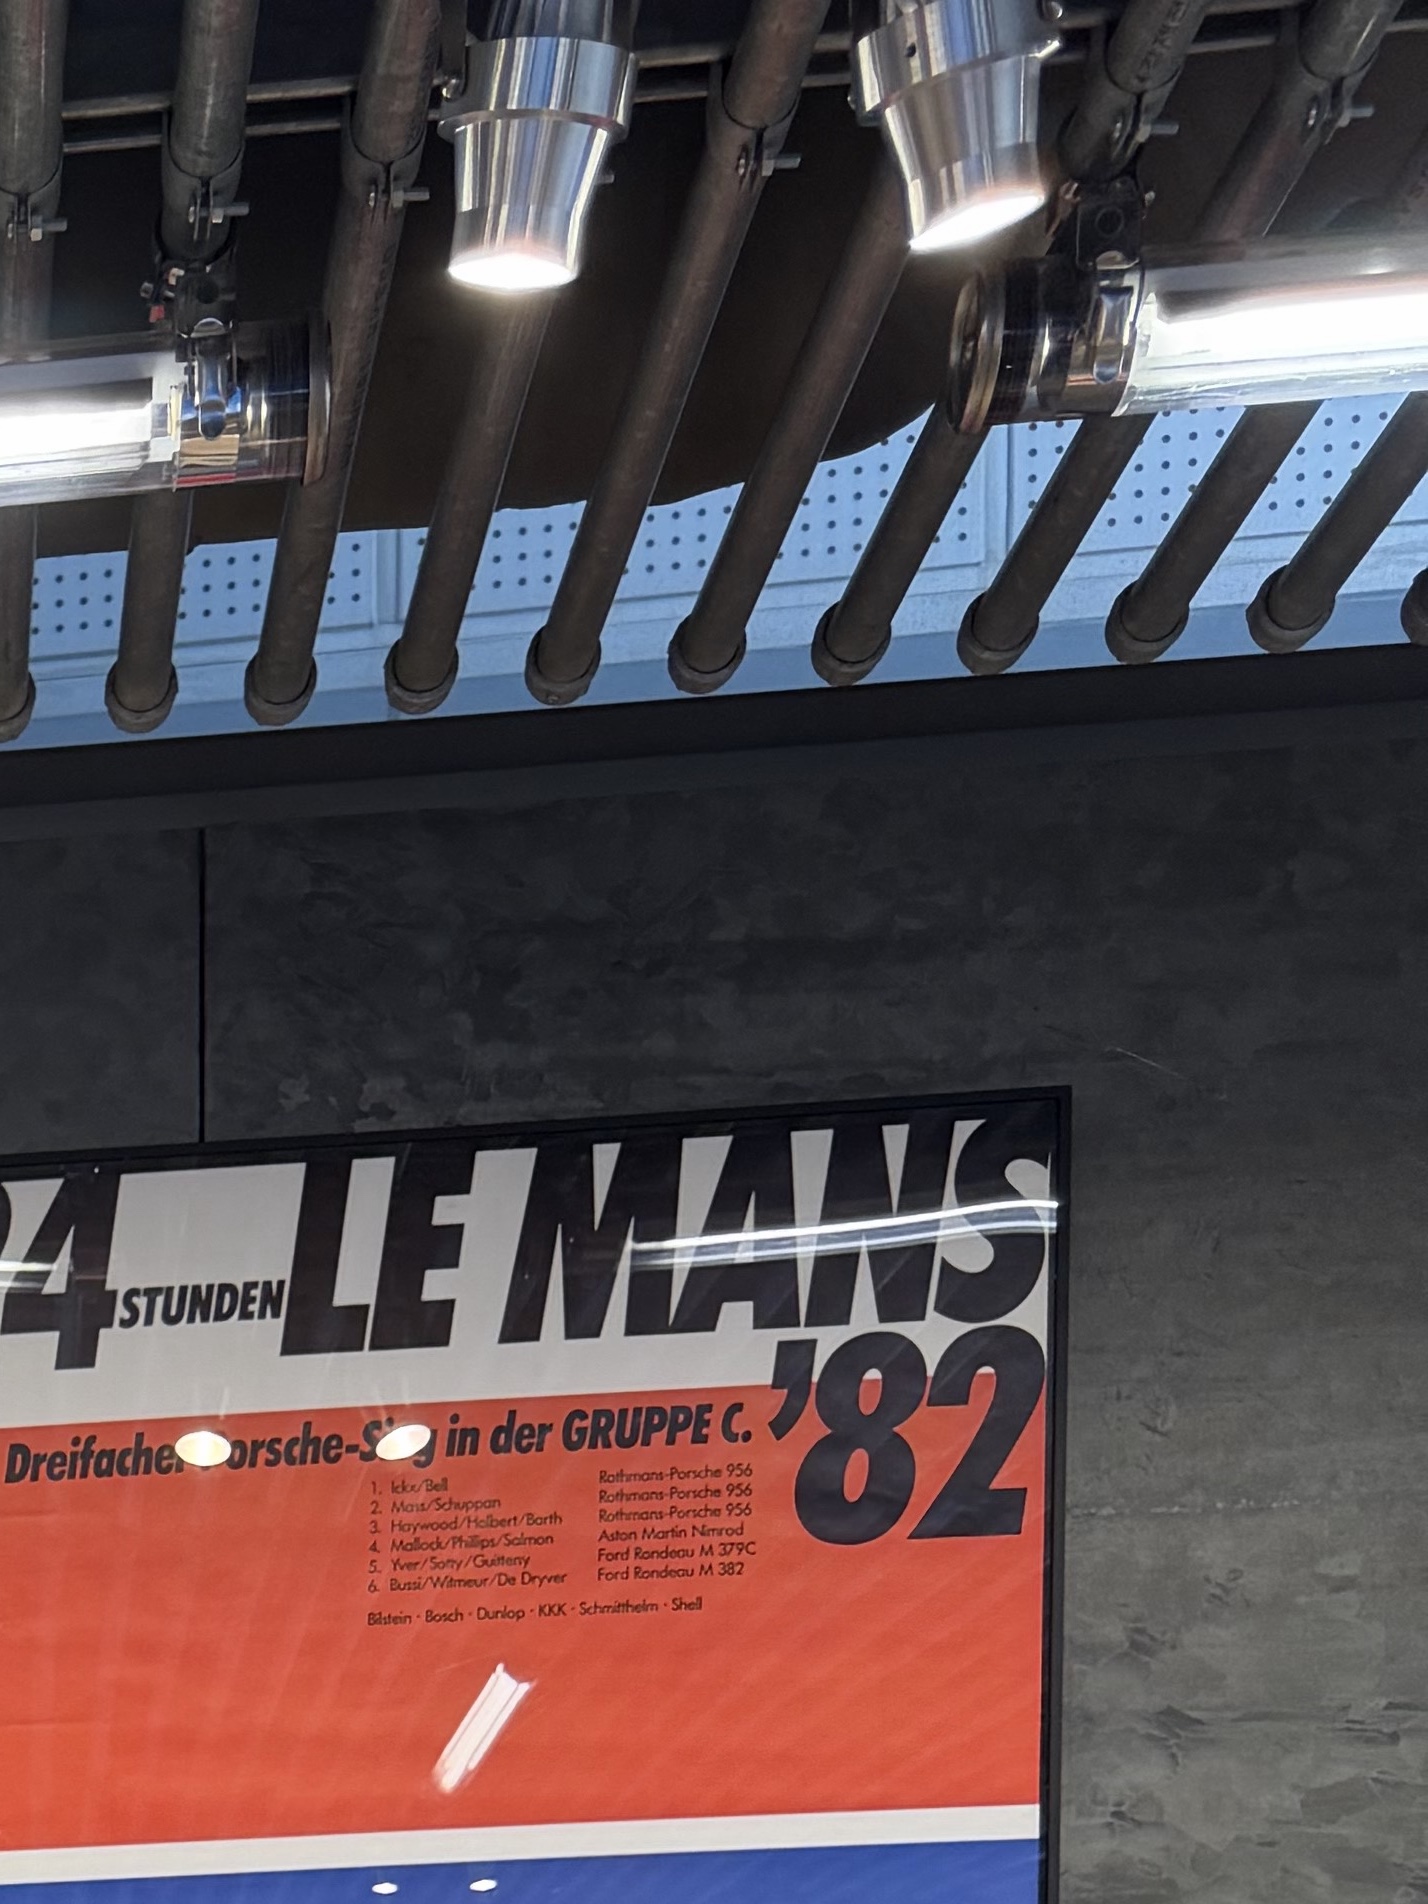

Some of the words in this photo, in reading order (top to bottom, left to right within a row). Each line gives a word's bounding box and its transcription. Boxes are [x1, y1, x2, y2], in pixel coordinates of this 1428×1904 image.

[118, 1279, 286, 1330] STUNDEN
[279, 1150, 478, 1357] LE
[497, 1105, 1049, 1344] MANS
[4, 1431, 185, 1484] Dreifacher
[445, 1412, 481, 1458] in
[489, 1409, 554, 1455] der
[561, 1403, 713, 1452] GRUPPE
[720, 1402, 753, 1444] C.
[599, 1467, 722, 1485] Rothmans-Porsche
[725, 1463, 754, 1479] 956
[599, 1486, 722, 1504] Rothmans-Porsche
[725, 1483, 754, 1498] 956
[599, 1506, 722, 1523] Rothmans-Porsche
[725, 1503, 754, 1517] 956
[597, 1529, 637, 1543] Aston
[641, 1525, 687, 1540] Martin
[691, 1522, 745, 1538] Nimrod
[597, 1547, 630, 1562] Ford
[633, 1545, 695, 1562] Rondeau
[700, 1543, 715, 1558] M
[718, 1541, 756, 1556] 379C
[597, 1566, 630, 1582] Ford
[633, 1565, 695, 1581] Rondeau
[700, 1563, 714, 1577] M
[718, 1562, 745, 1577] 382
[367, 1610, 413, 1627] Bilstein
[424, 1608, 464, 1624] Bosch
[476, 1605, 527, 1624] Dunlop
[537, 1603, 568, 1618] KKK
[670, 1597, 703, 1612] Shell
